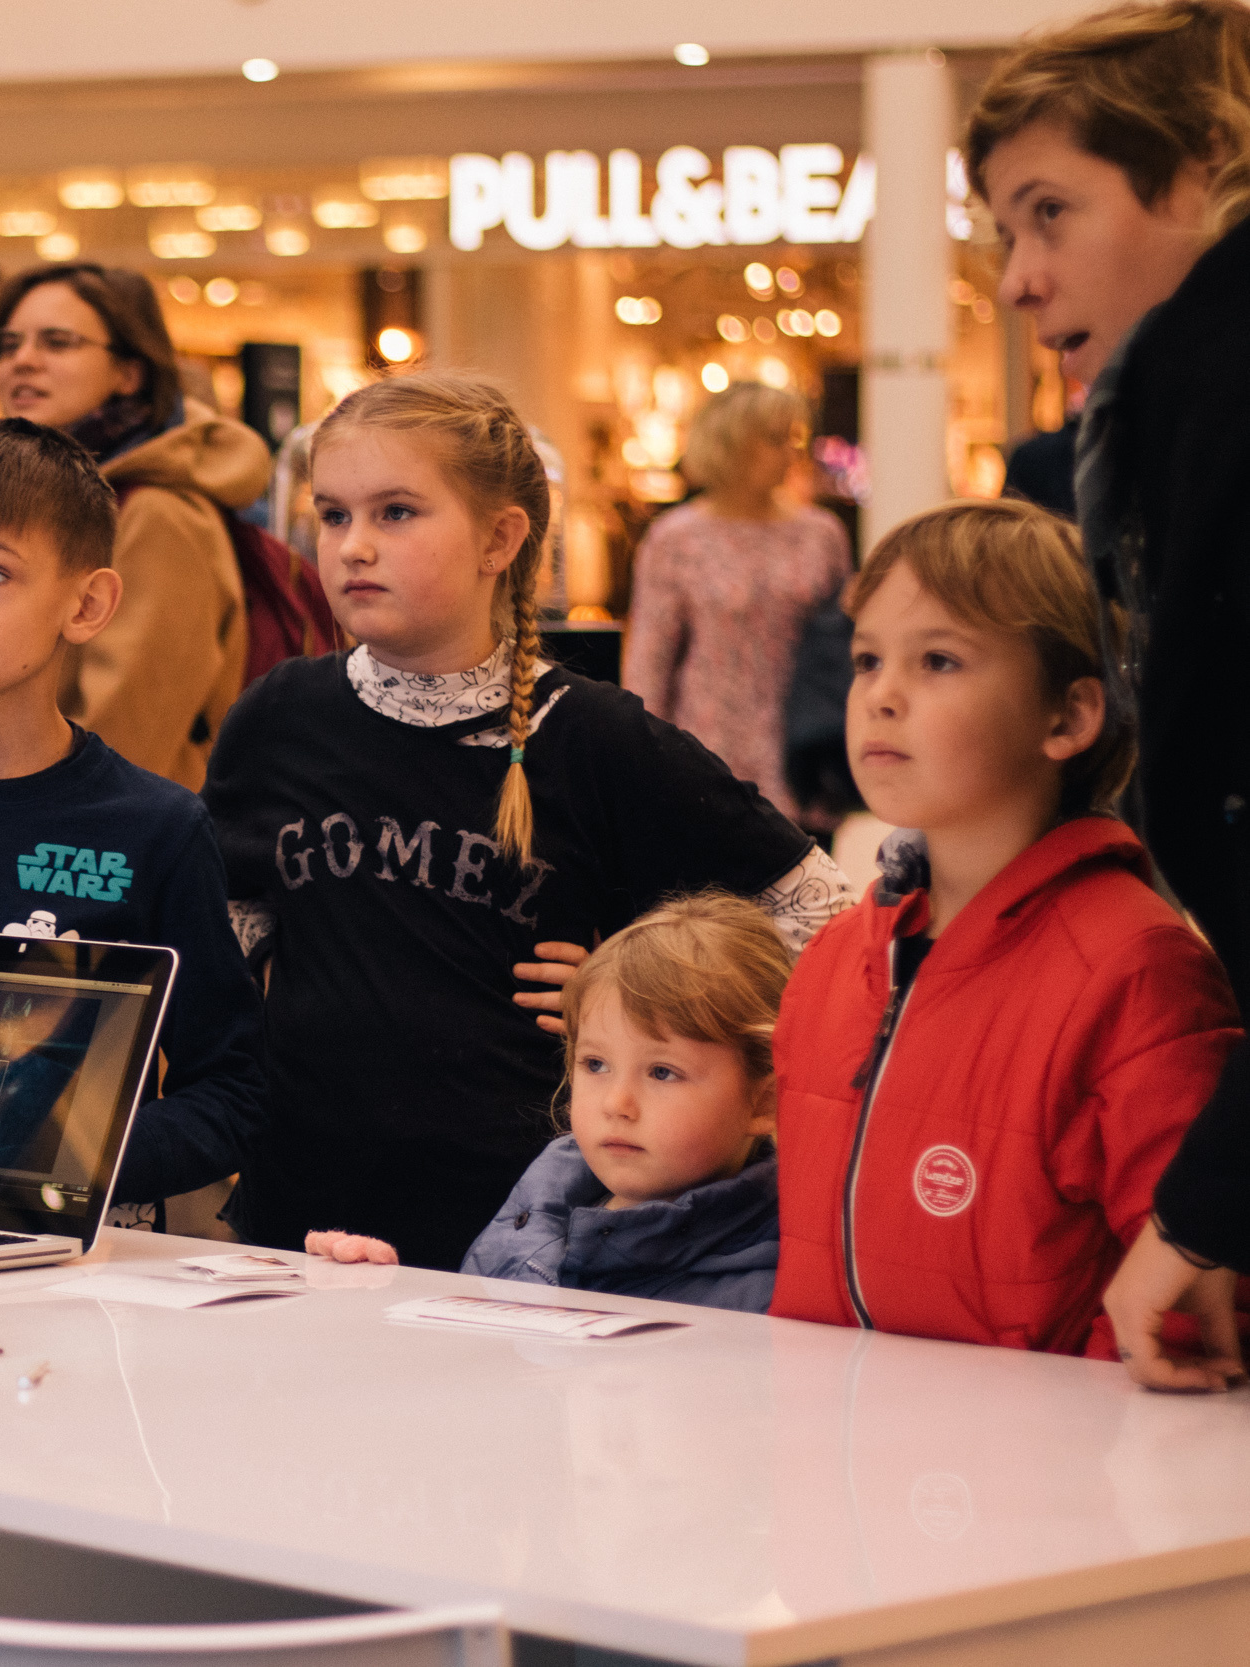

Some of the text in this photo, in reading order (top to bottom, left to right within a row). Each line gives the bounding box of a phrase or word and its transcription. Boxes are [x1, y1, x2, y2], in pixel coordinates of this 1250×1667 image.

[17, 842, 134, 879] STAR
[275, 812, 556, 931] GOMEZ
[17, 864, 133, 903] WARS
